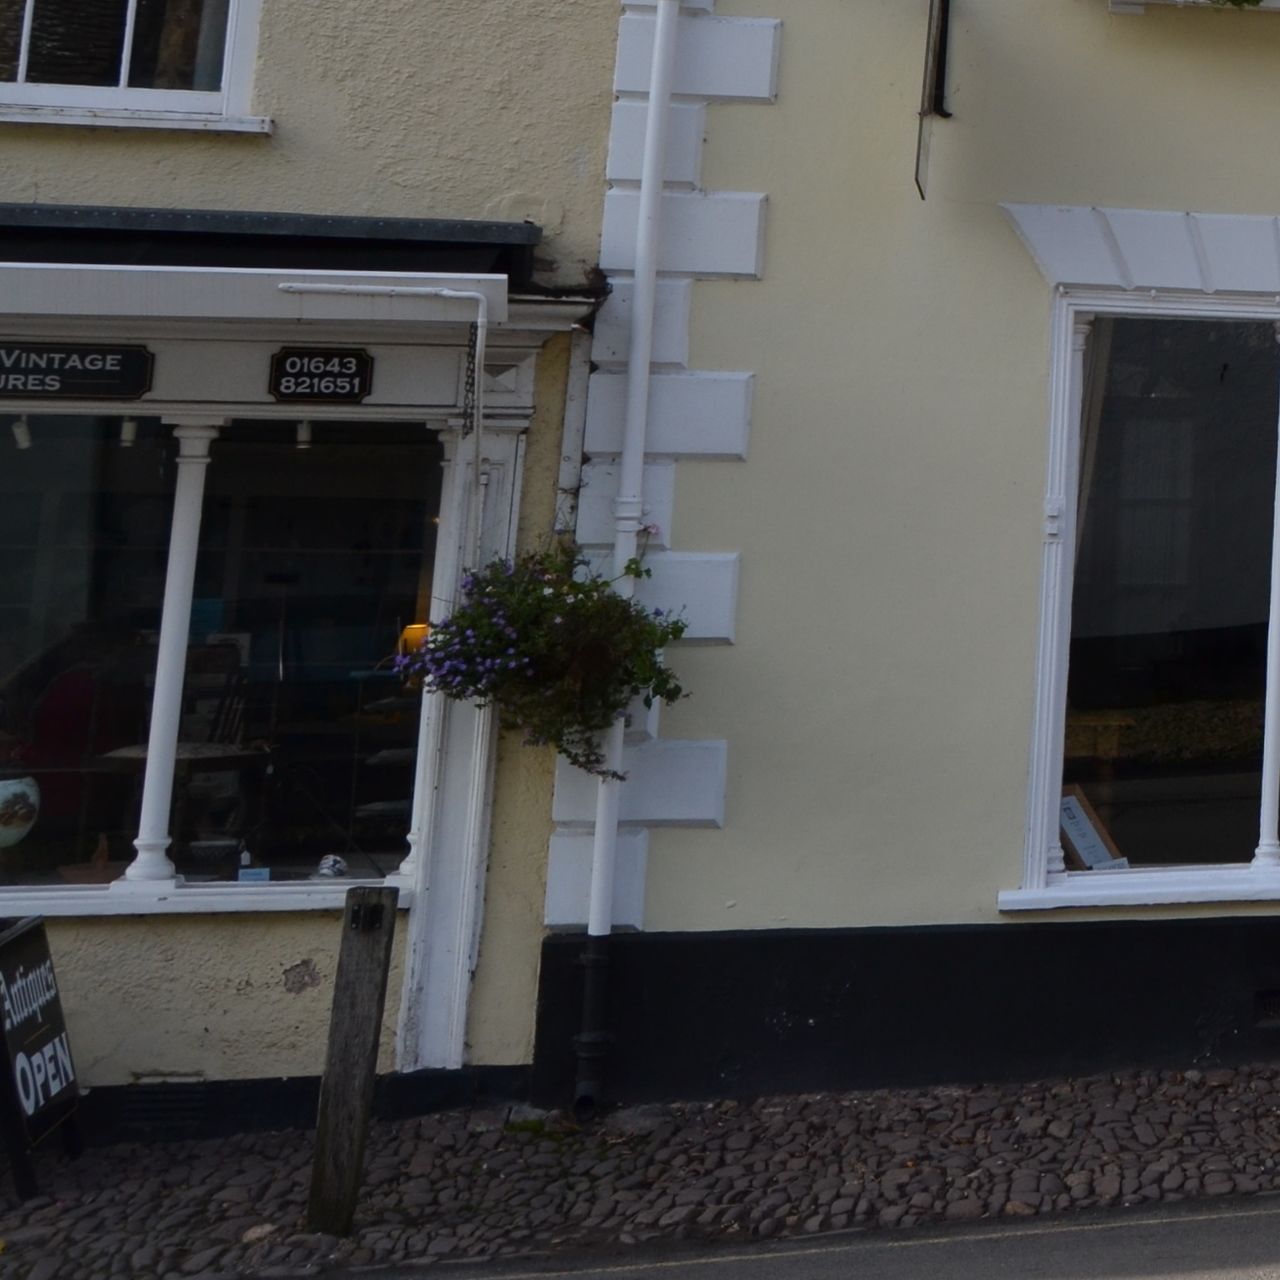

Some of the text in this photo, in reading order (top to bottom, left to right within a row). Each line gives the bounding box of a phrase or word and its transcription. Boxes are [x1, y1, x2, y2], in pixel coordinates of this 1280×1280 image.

[0, 349, 122, 371] VINTAGE
[286, 356, 357, 373] 01643
[279, 376, 360, 393] 821651
[15, 1031, 75, 1115] OPEN
